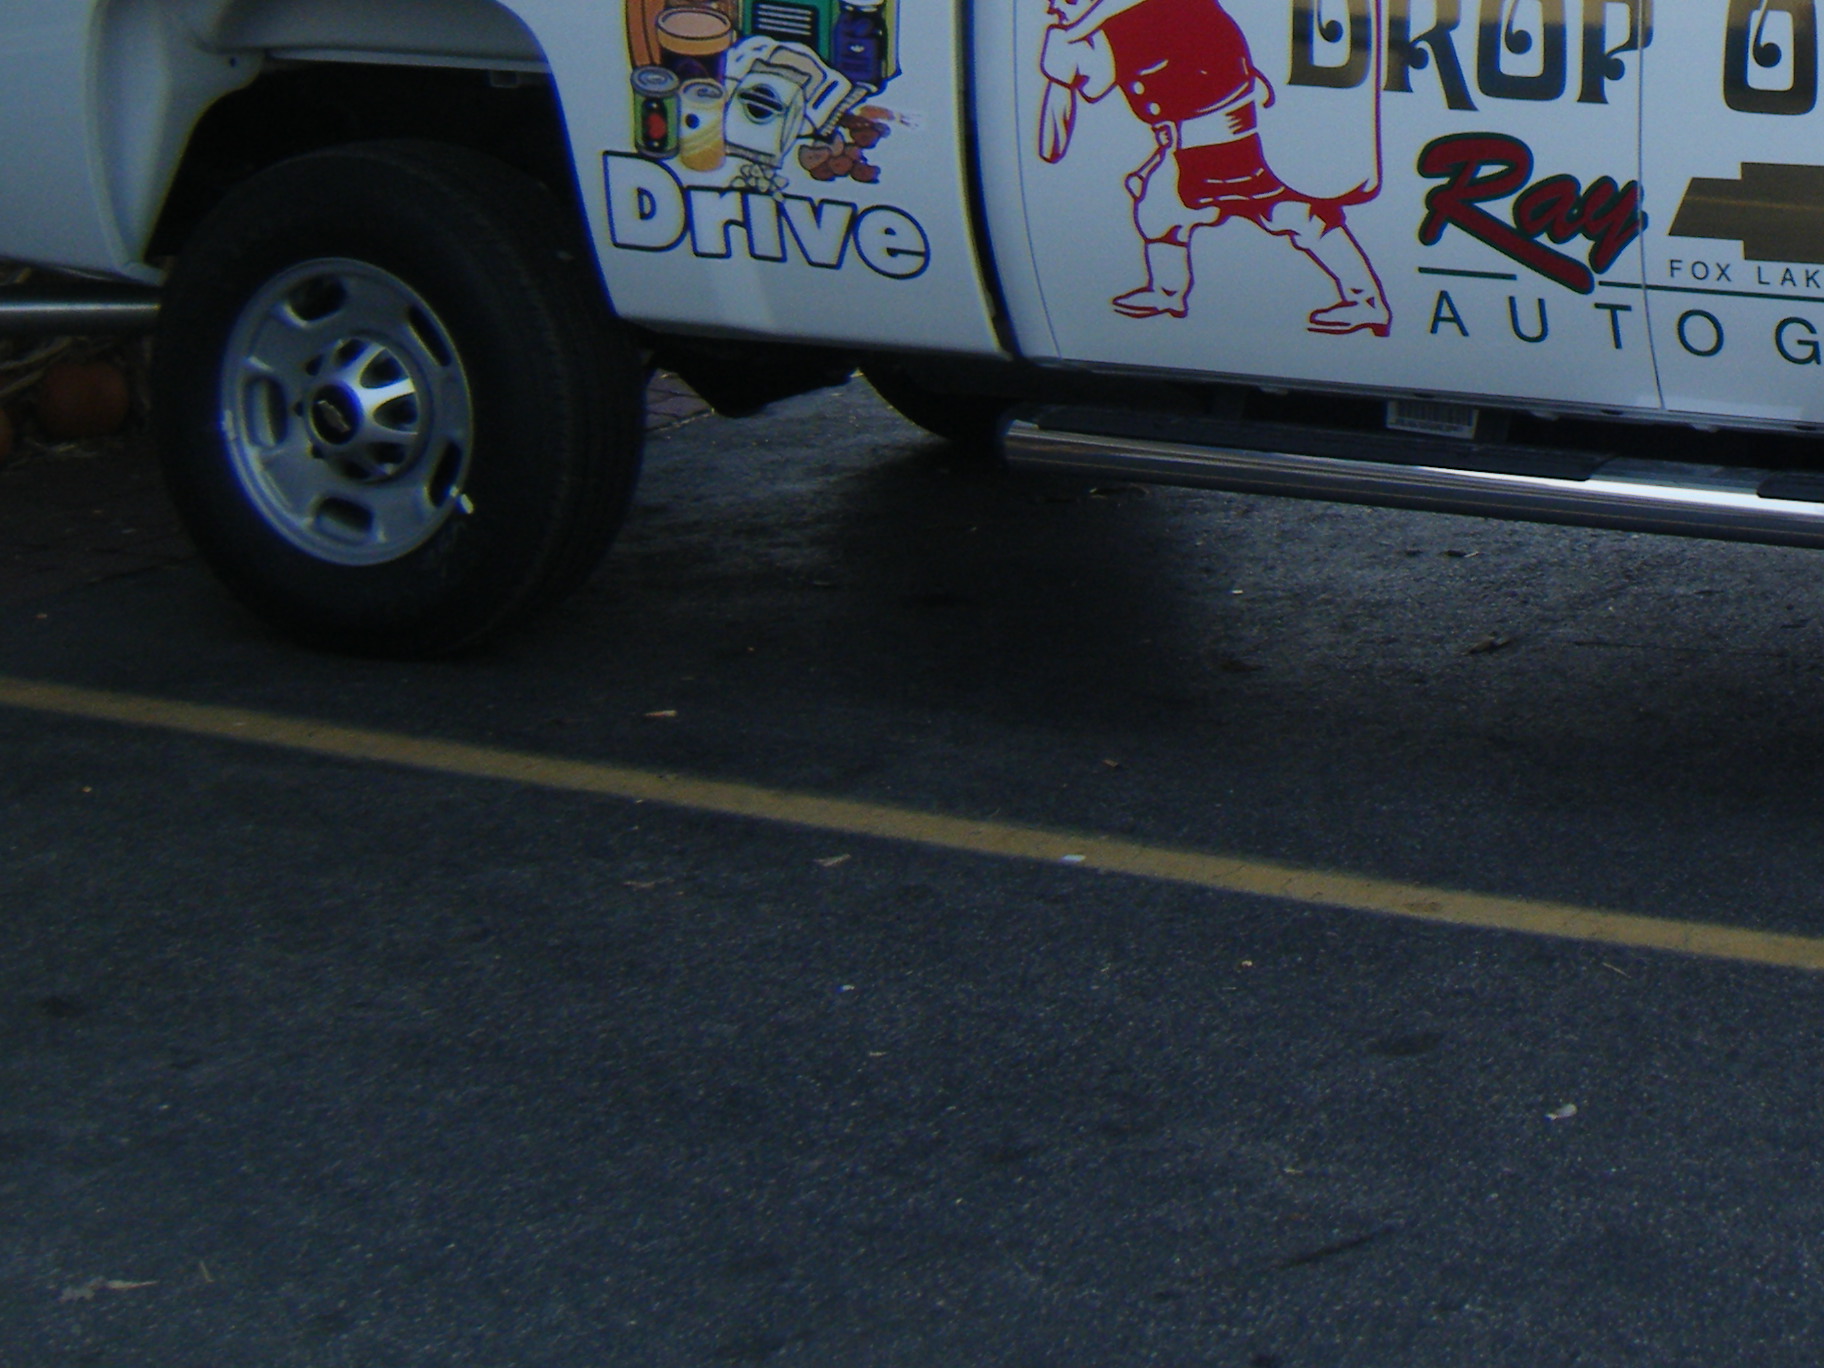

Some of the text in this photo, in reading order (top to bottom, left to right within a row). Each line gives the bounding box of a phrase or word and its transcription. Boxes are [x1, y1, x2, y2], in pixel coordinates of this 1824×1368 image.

[602, 150, 931, 279] Drive
[1417, 131, 1648, 294] Ray
[1669, 259, 1733, 283] FOX
